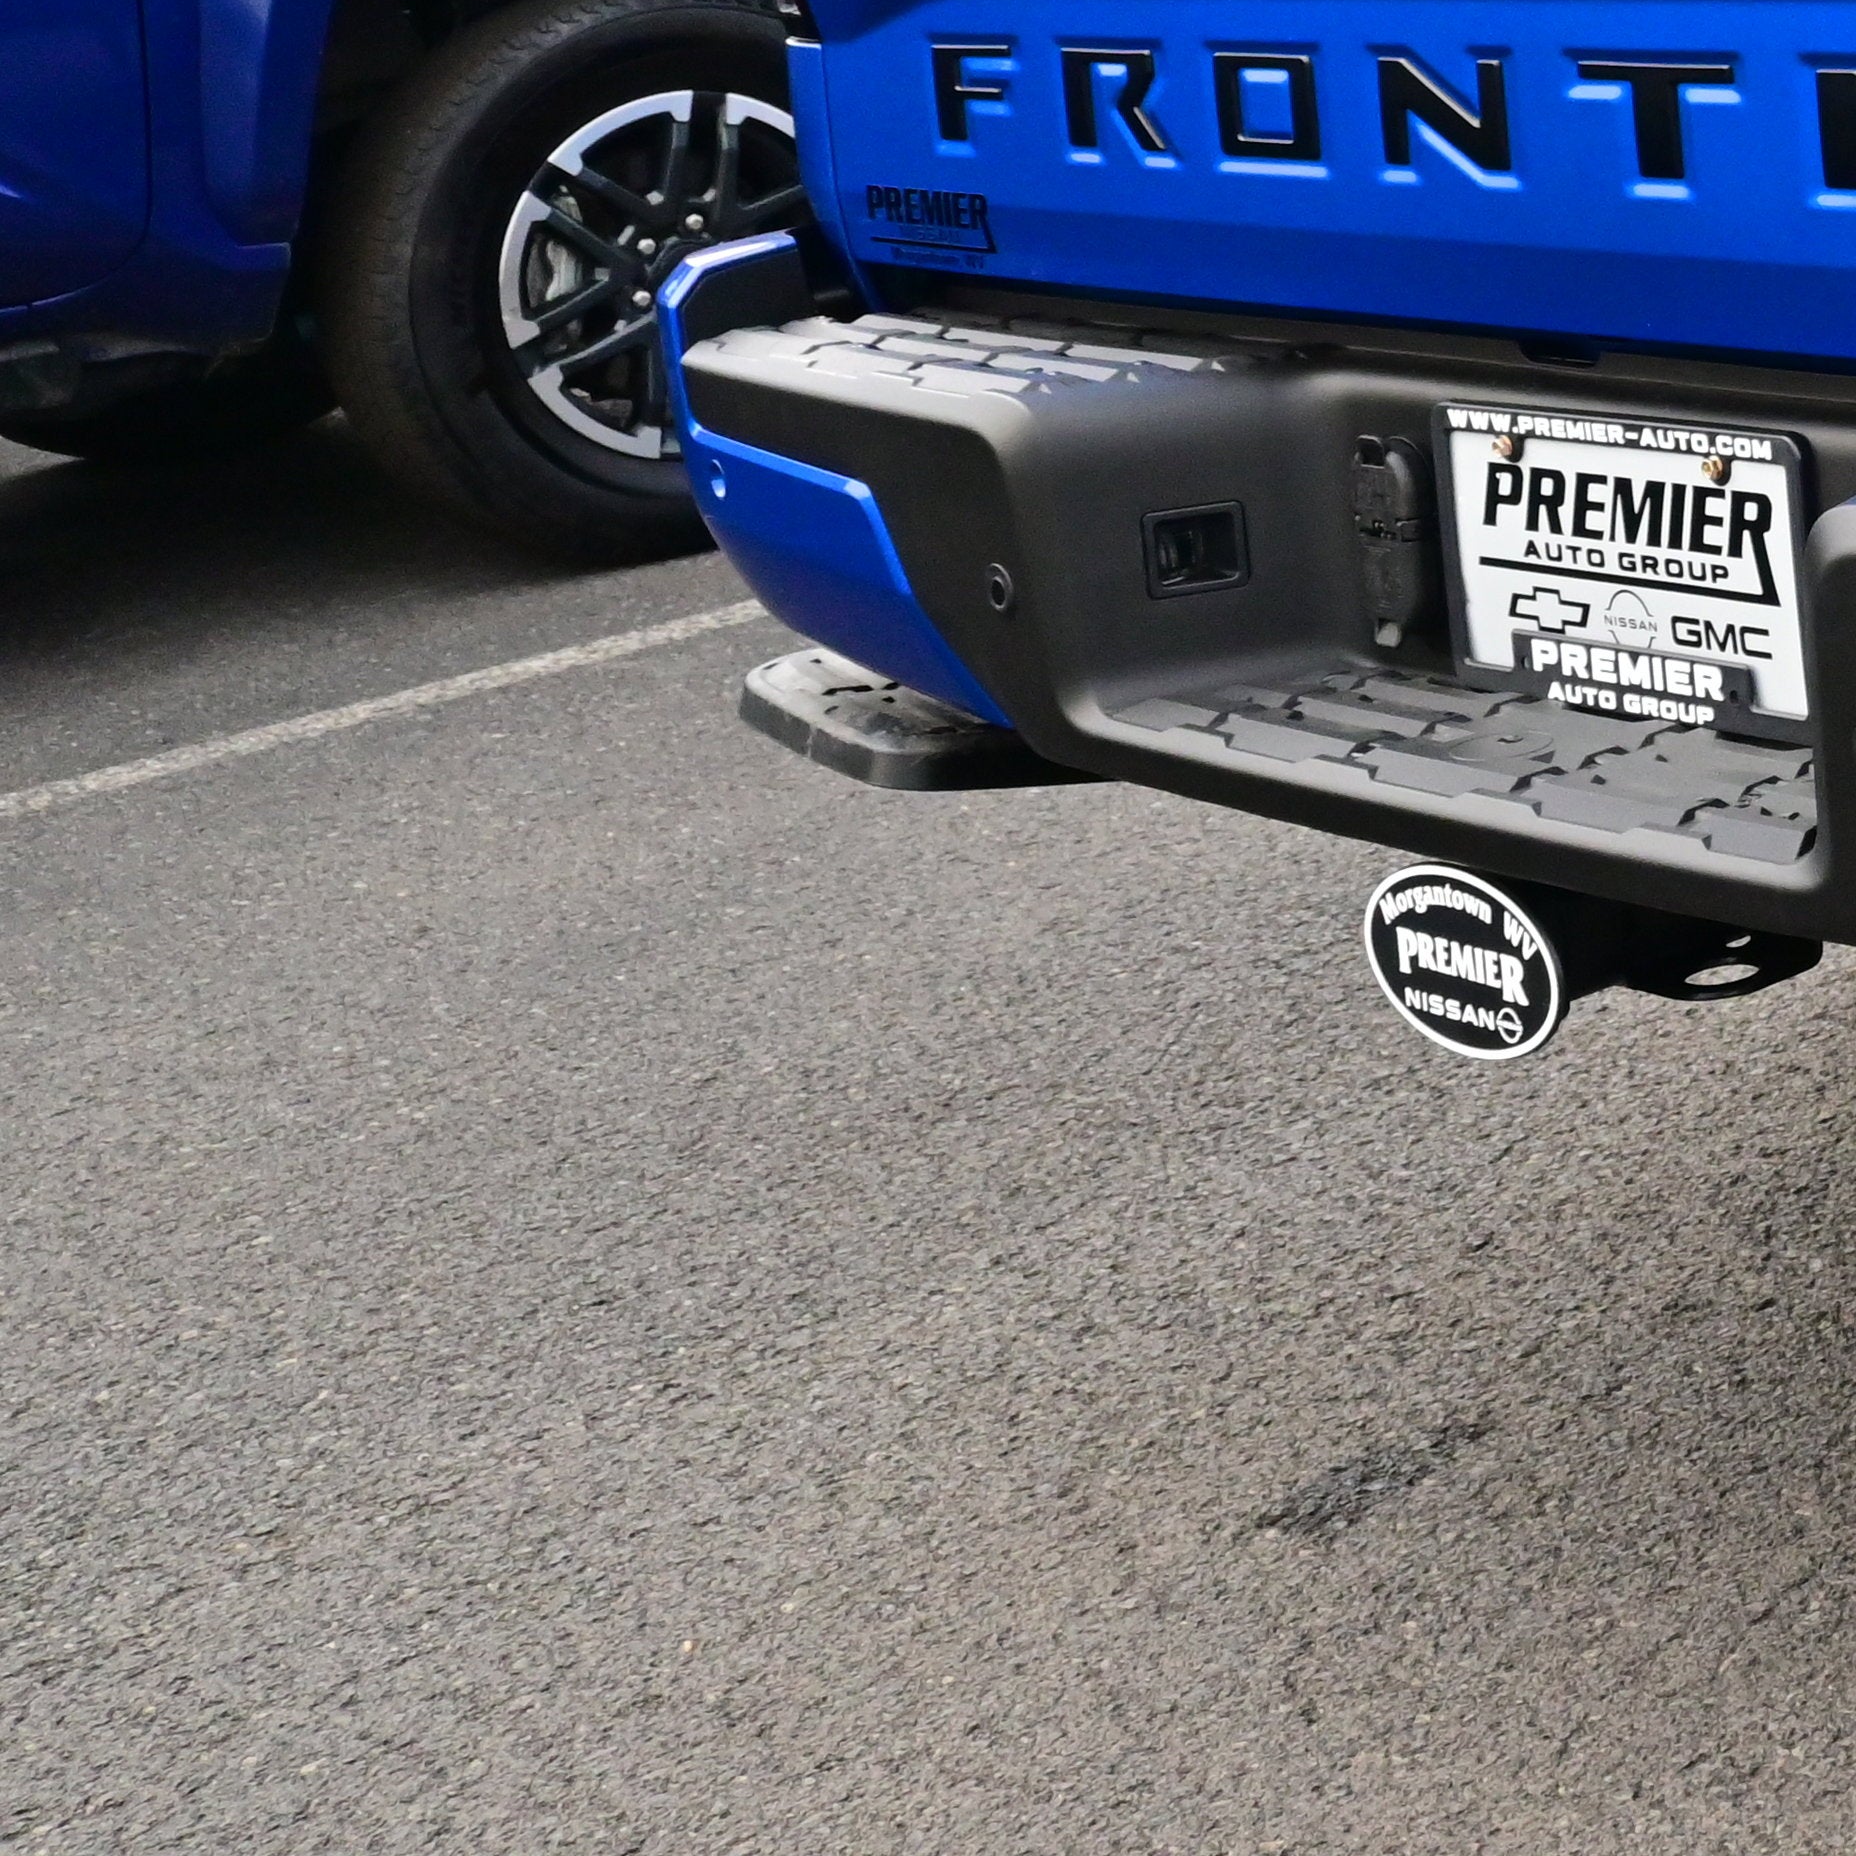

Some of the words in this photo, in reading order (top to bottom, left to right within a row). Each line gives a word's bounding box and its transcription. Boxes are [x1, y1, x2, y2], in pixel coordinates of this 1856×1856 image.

[866, 184, 992, 232] PREMIER
[1446, 408, 1774, 462] WWW.PREMIER-AUTO.COM
[1482, 461, 1777, 566] PREMIER
[1523, 540, 1605, 569] AUTO
[1617, 551, 1731, 585] GROUP
[1603, 614, 1659, 633] NISSAN
[1670, 615, 1773, 660] GMC
[1530, 637, 1726, 702] PREMIER
[1547, 681, 1618, 711] AUTO
[1622, 691, 1716, 726] GROUP
[1379, 882, 1493, 925] Morgantown
[1502, 910, 1541, 960] WV
[1395, 926, 1530, 1007] PREMIER
[1403, 986, 1497, 1032] NISSAN
